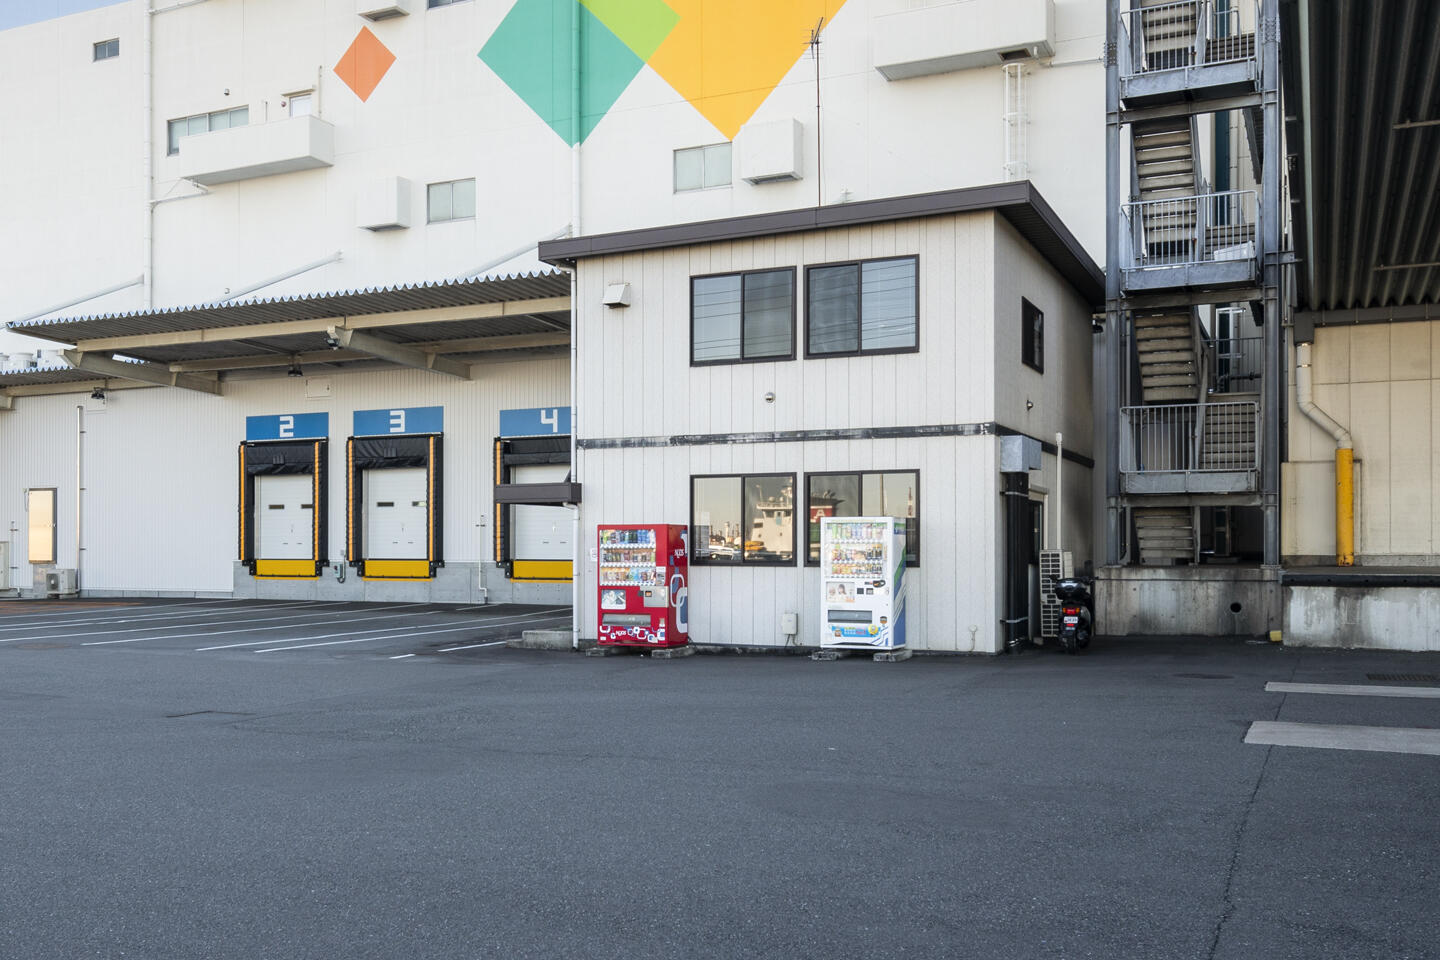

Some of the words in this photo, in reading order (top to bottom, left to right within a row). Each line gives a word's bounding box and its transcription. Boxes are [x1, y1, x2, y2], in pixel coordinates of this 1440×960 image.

[279, 415, 294, 438] 2
[389, 409, 405, 433] 3
[540, 408, 558, 433] 4
